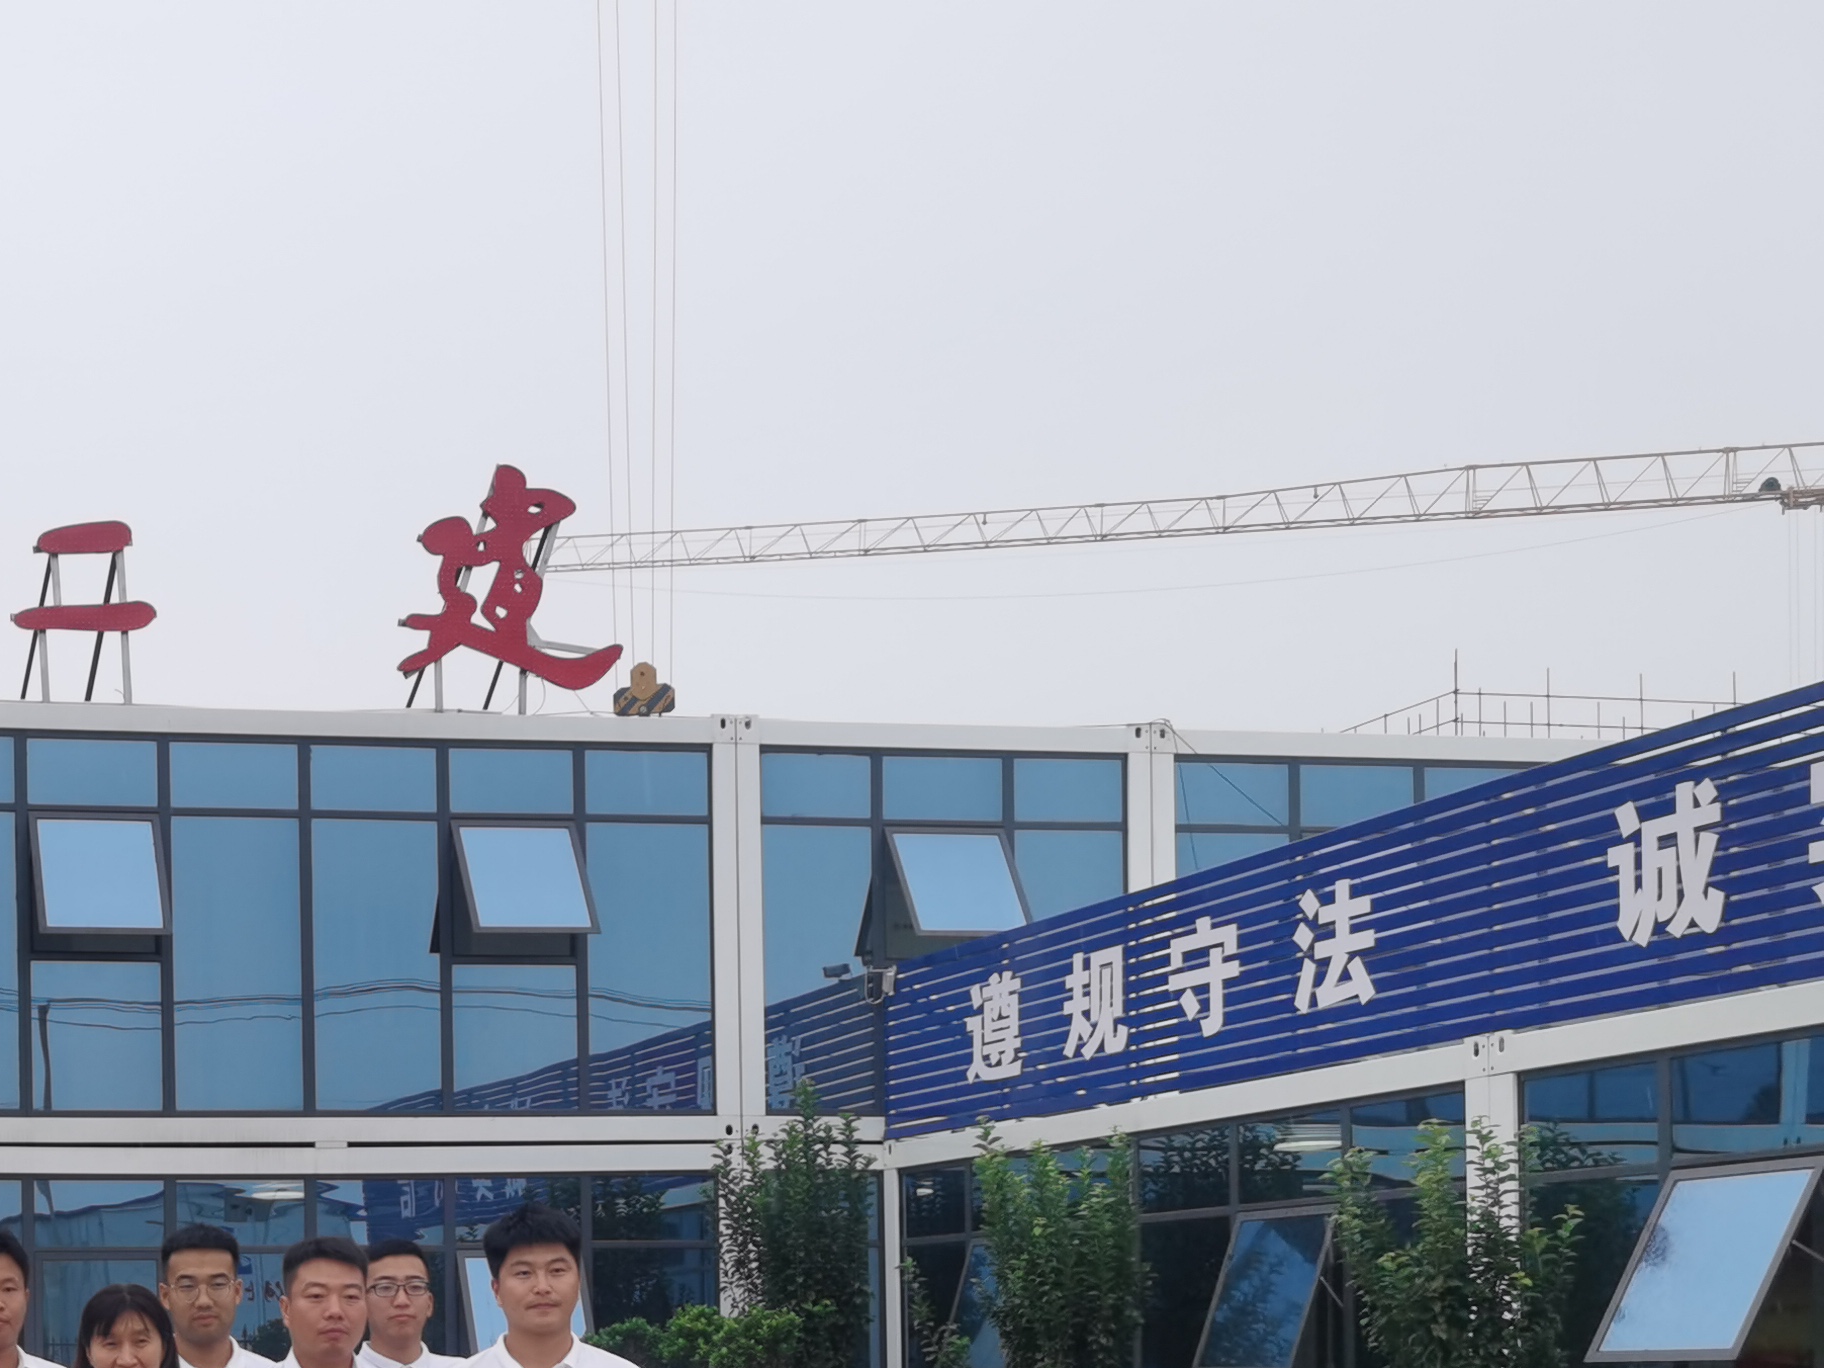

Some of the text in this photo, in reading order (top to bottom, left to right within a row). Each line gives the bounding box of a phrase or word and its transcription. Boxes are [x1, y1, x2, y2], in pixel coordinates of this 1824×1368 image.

[1607, 762, 1824, 948] 诚
[966, 879, 1375, 1084] 遵规守法
